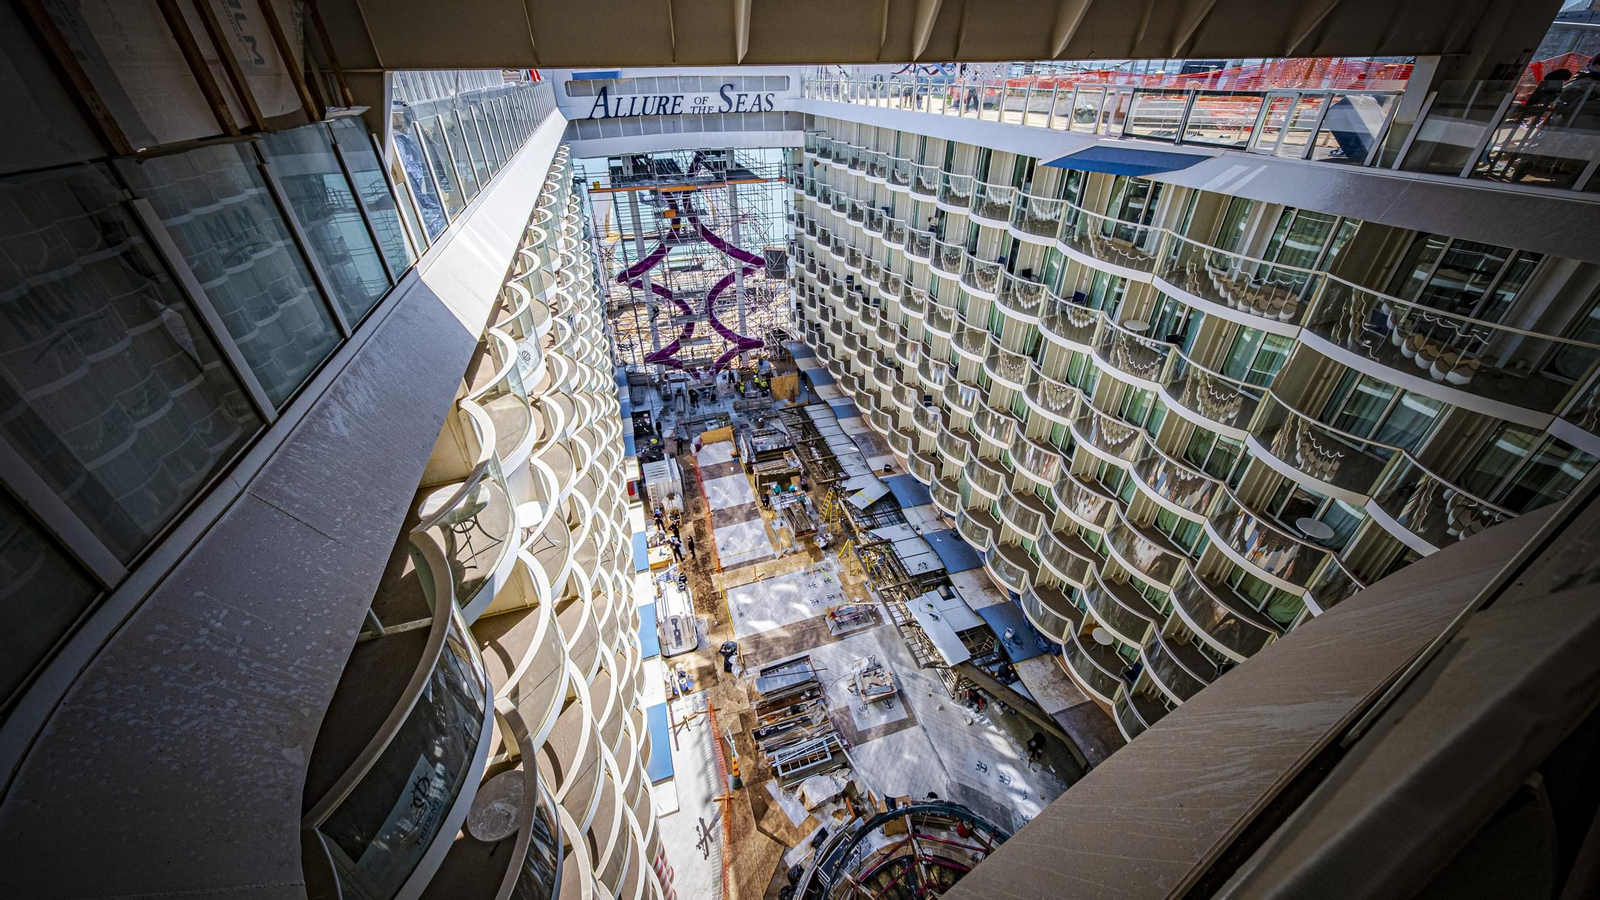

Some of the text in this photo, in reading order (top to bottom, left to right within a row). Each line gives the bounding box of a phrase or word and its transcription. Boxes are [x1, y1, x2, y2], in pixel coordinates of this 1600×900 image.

[586, 83, 775, 121] ALLURE OF THE SEAS
